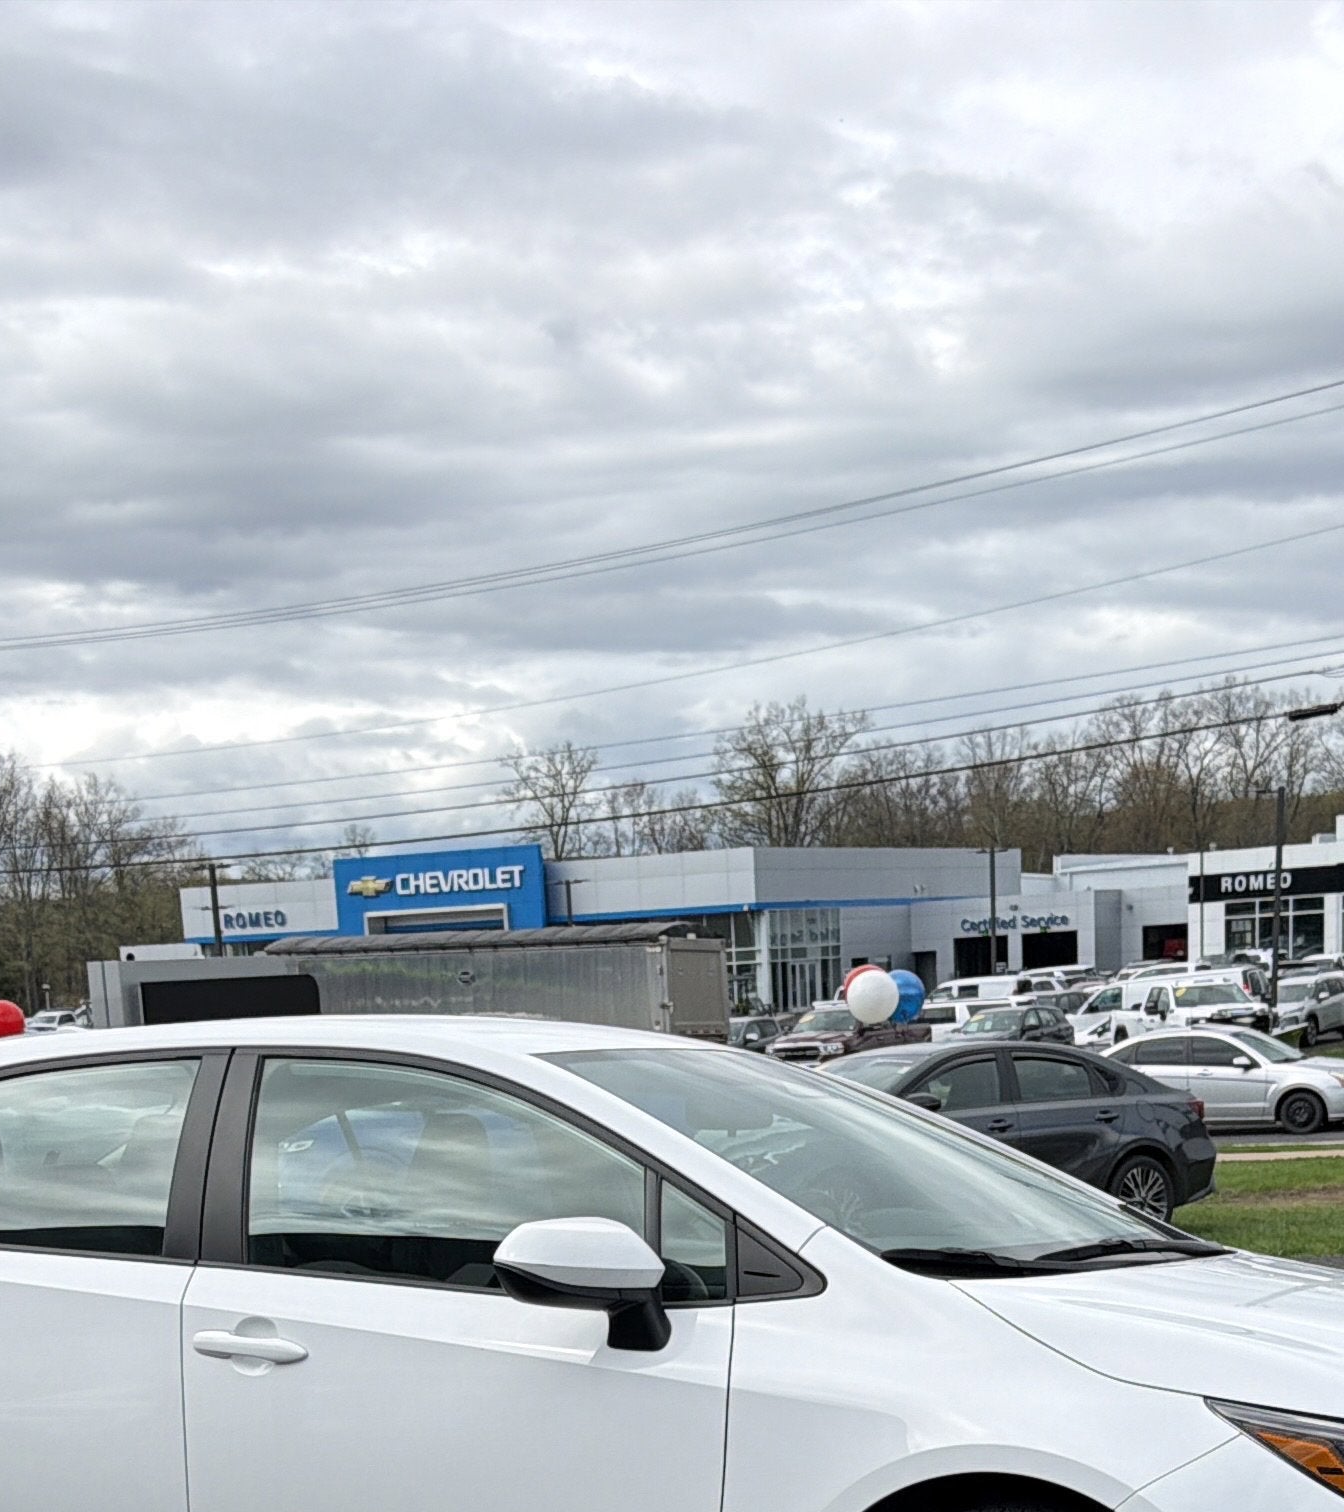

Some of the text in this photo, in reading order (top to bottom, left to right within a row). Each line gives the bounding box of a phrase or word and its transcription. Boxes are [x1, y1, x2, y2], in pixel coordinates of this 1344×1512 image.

[395, 865, 525, 896] CHEVROLET
[1220, 872, 1292, 893] ROMEO
[223, 910, 288, 930] ROMEO
[1021, 913, 1069, 928] Service
